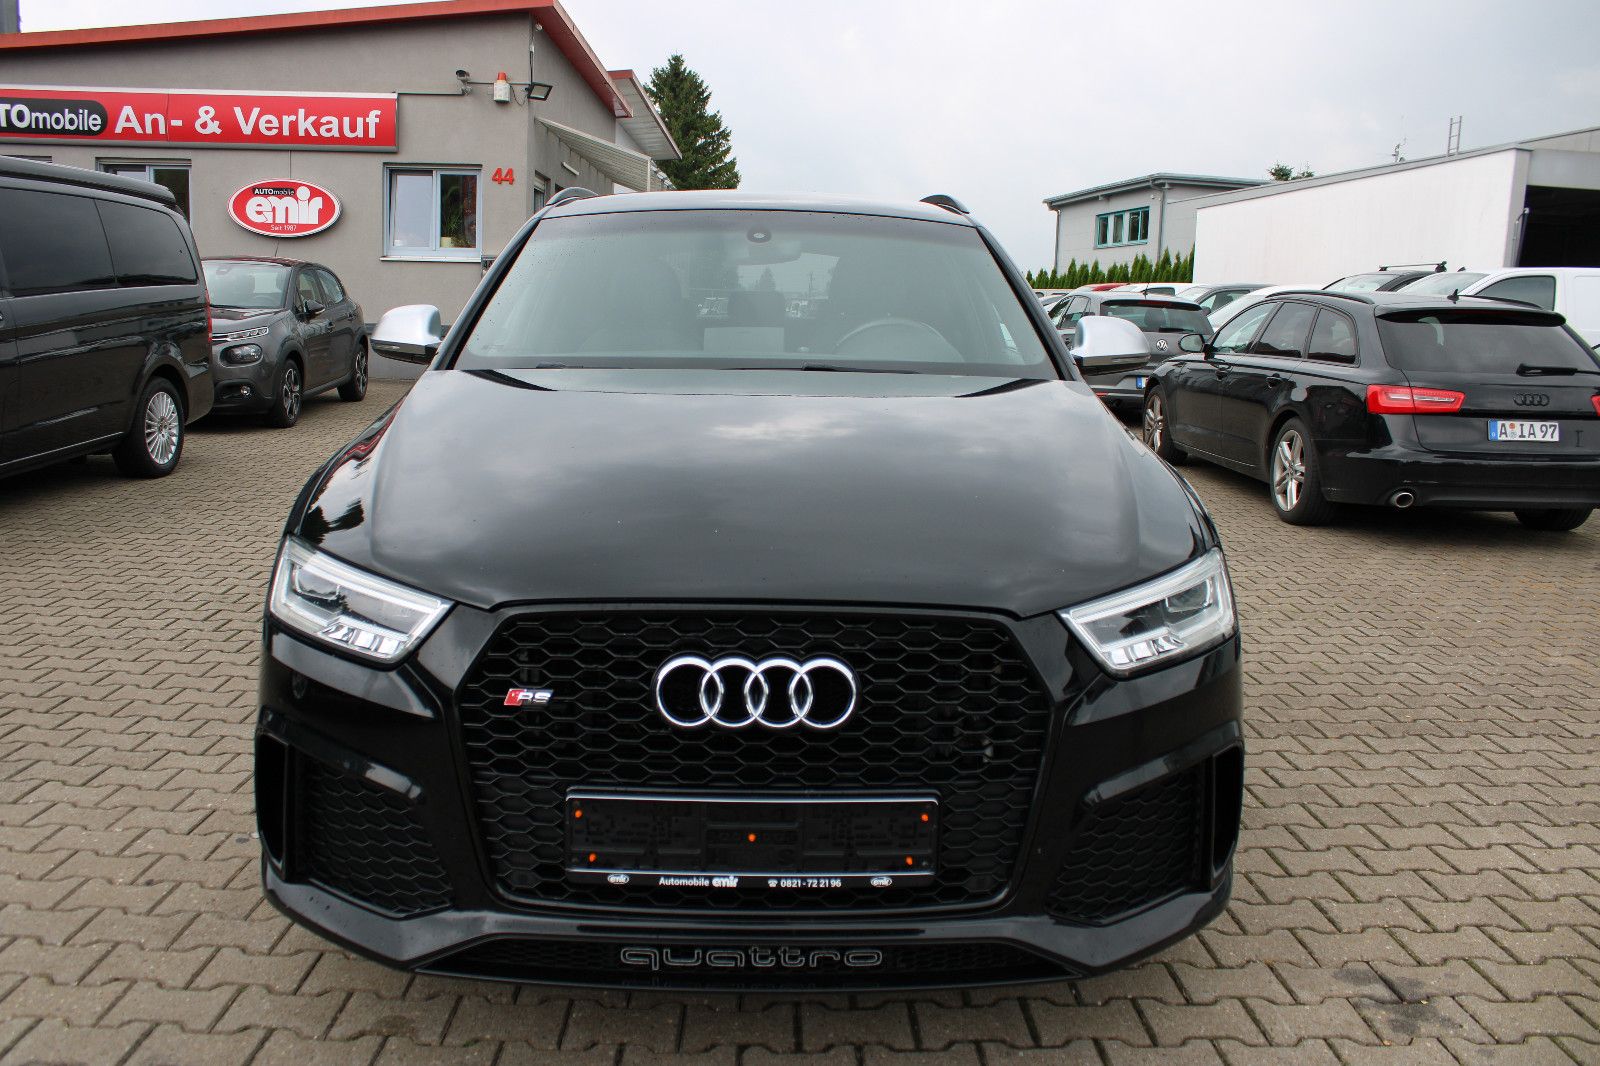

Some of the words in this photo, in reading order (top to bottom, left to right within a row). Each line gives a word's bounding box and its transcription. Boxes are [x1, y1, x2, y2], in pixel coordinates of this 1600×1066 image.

[114, 105, 183, 135] An-
[194, 105, 223, 135] &
[233, 106, 382, 139] Verkauf
[491, 167, 515, 185] 44
[254, 188, 295, 196] AUTOmobile
[245, 185, 323, 224] emir
[1498, 422, 1508, 438] A
[1518, 423, 1537, 439] IA
[1540, 424, 1558, 439] 97
[516, 691, 551, 704] RS
[659, 877, 710, 887] Automobile
[711, 875, 739, 888] emir
[620, 946, 883, 971] quattro
